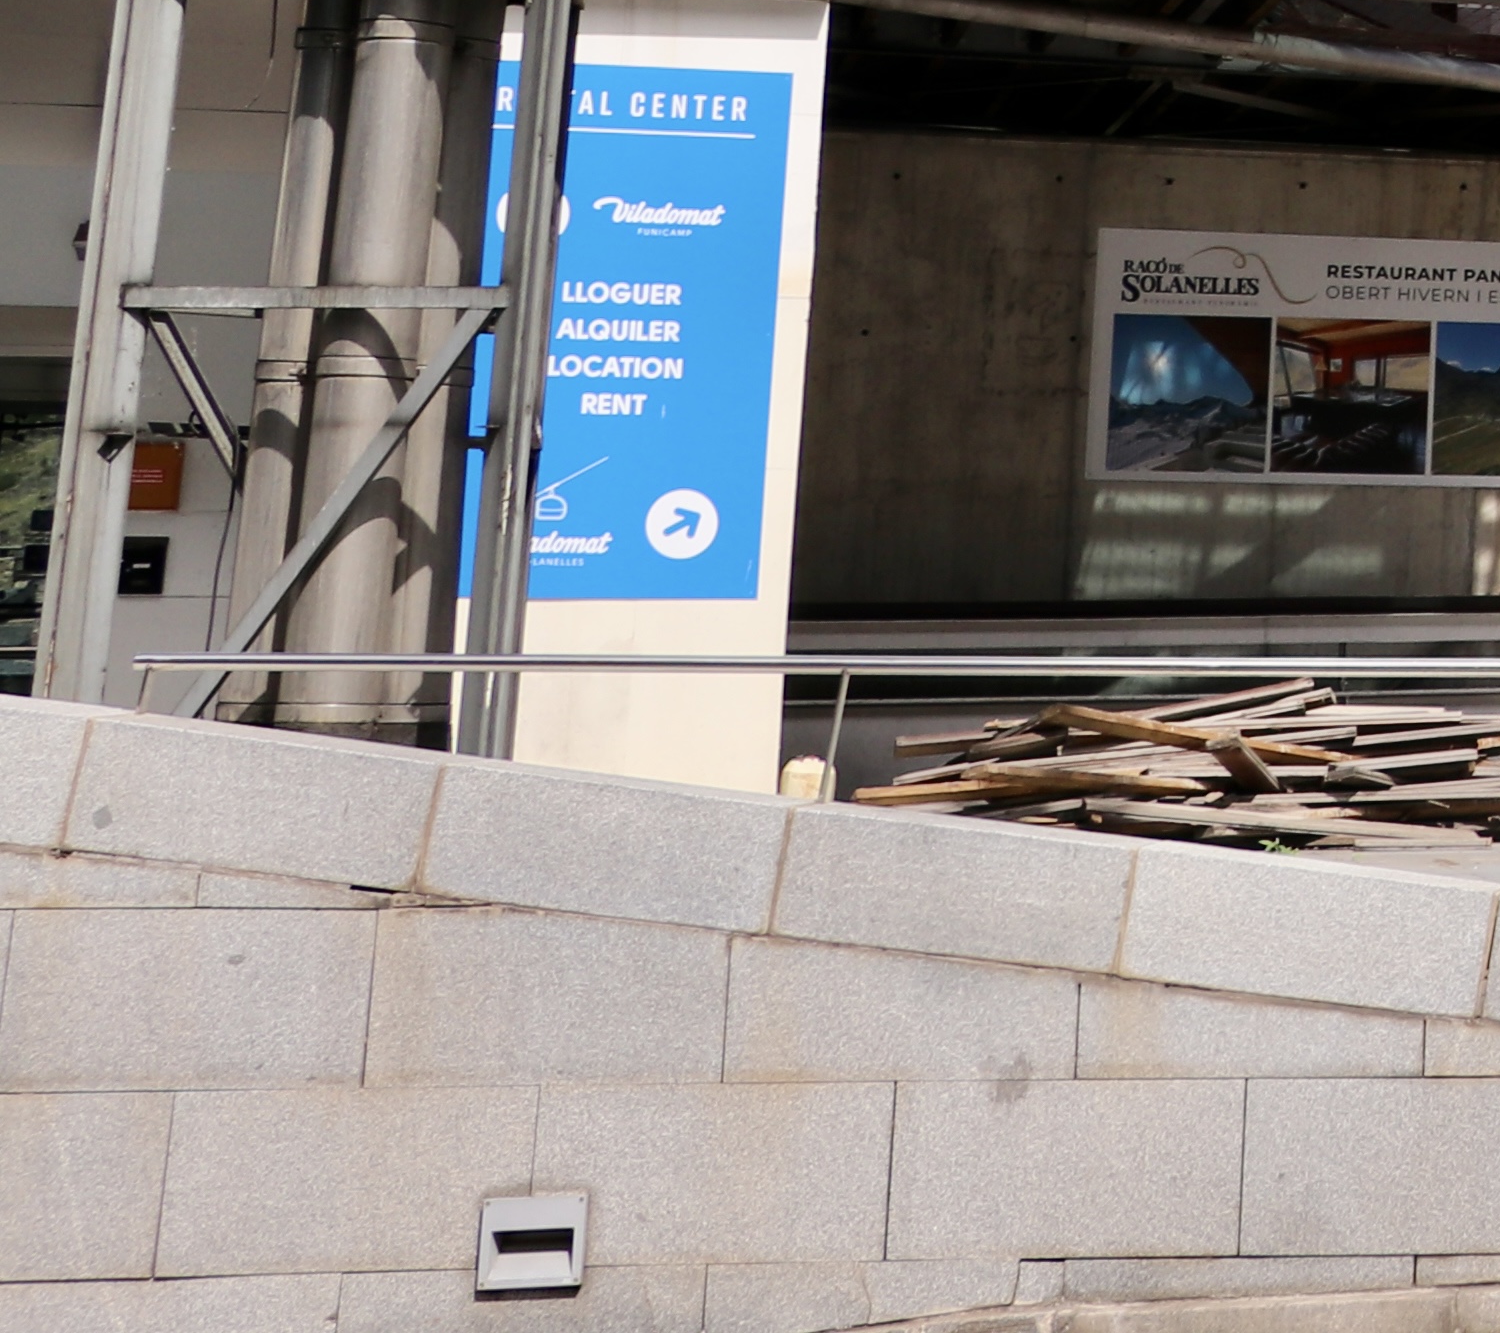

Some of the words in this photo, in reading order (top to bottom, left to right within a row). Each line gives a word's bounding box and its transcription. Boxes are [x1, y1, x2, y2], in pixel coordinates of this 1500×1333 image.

[496, 86, 613, 116] RAL
[630, 91, 747, 122] CENTER
[593, 196, 726, 226] Viladomat
[637, 227, 692, 237] FUNICAMP
[1123, 257, 1167, 274] RACÓ
[1168, 263, 1184, 274] DE
[1327, 264, 1458, 282] RESTAURANT
[562, 281, 682, 306] LLOGUER
[1121, 274, 1260, 302] SOLANELLES
[1326, 285, 1391, 301] OBERT
[1397, 287, 1470, 303] HIVERN
[555, 317, 681, 343] ALQUILER
[547, 354, 684, 380] LOCATION
[580, 392, 648, 416] RENT
[528, 530, 613, 555] adomat
[531, 557, 585, 567] LANELLES
